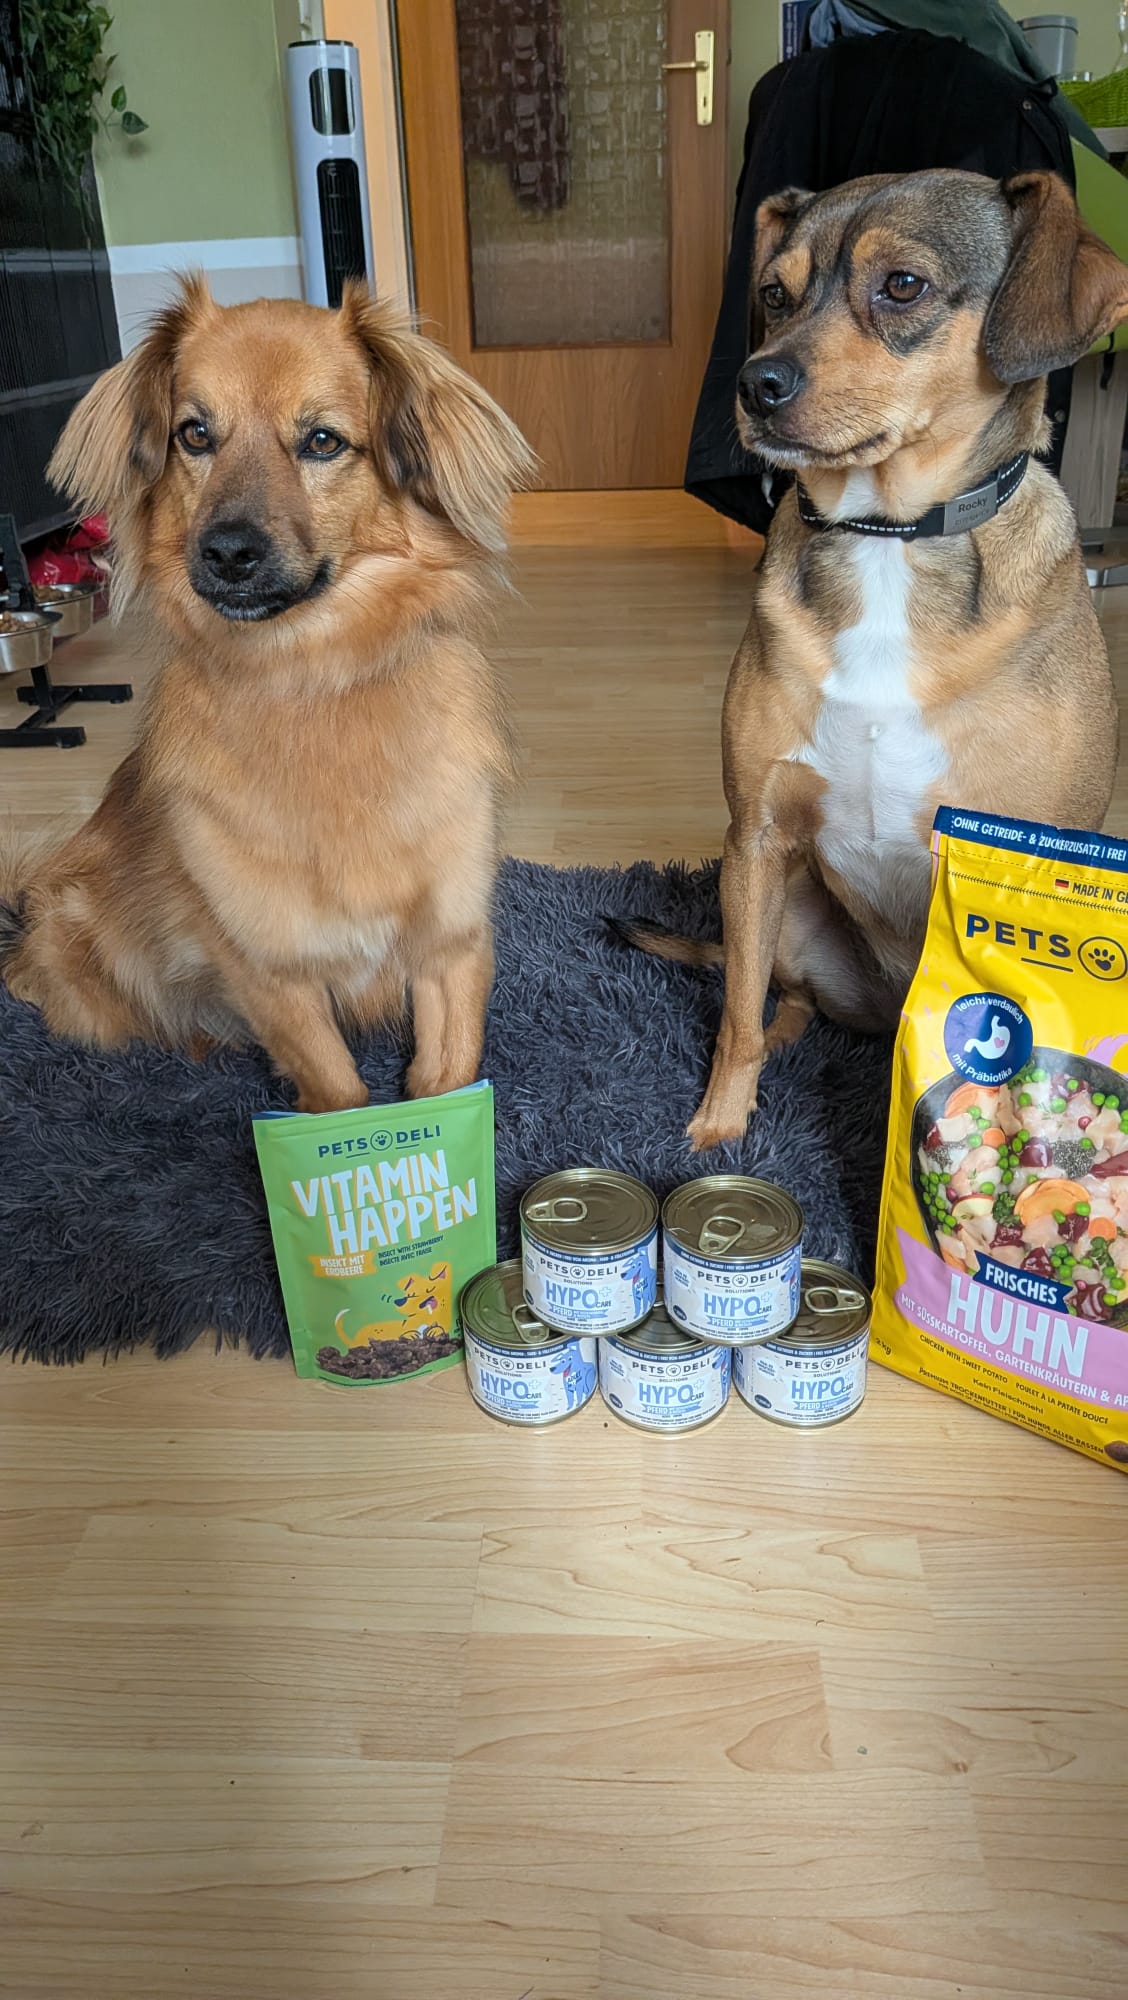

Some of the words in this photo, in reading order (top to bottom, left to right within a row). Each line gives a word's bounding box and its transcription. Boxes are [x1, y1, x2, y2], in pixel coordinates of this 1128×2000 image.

[958, 496, 988, 513] Rocky
[953, 816, 980, 832] OHNE
[981, 823, 1027, 842] GETREIDE-
[1028, 833, 1037, 845] &
[1038, 835, 1100, 857] ZUCKERZUSATZ
[1107, 847, 1127, 861] FREI
[1072, 882, 1100, 898] MADE
[1102, 887, 1113, 901] IN
[966, 913, 1072, 959] PETS
[955, 996, 986, 1012] leicht
[987, 998, 1024, 1025] verdaulich
[952, 1053, 967, 1070] mit
[965, 1066, 1013, 1083] Präbiotika
[317, 1136, 368, 1158] PETS
[396, 1124, 441, 1143] DELI
[291, 1149, 449, 1217] VITAMIN
[327, 1177, 478, 1256] HAPPEN
[350, 1254, 364, 1265] MIT
[397, 1244, 411, 1254] WITH
[540, 1257, 569, 1274] PETS
[588, 1266, 617, 1277] DELI
[697, 1270, 730, 1285] PETS
[751, 1270, 779, 1284] DELI
[546, 1279, 599, 1309] HYPO
[985, 1263, 1058, 1305] FRISCHES
[704, 1293, 761, 1317] HYPO
[712, 1317, 734, 1327] PFERD
[946, 1273, 1089, 1378] HUHN
[474, 1346, 499, 1366] PETS
[517, 1361, 546, 1370] DELI
[785, 1360, 818, 1370] PETS
[837, 1348, 860, 1366] DELI
[901, 1292, 916, 1312] MIT
[995, 1349, 1097, 1399] GARTENKRÄUTERN
[1100, 1390, 1110, 1403] &
[920, 1334, 945, 1353] CHICKEN
[946, 1349, 961, 1362] WITH
[962, 1358, 981, 1372] SWEET
[982, 1367, 1008, 1383] POTATO
[632, 1361, 664, 1374] PETS
[684, 1358, 710, 1373] DELI
[480, 1369, 529, 1399] HYPO
[639, 1382, 693, 1405] HYPO
[791, 1377, 845, 1400] HYPO
[973, 1378, 992, 1391] Kein
[992, 1386, 1044, 1415] Fleischmehl
[951, 1381, 1007, 1411] TROCKENFUTTER
[1012, 1408, 1026, 1419] FÜR
[1028, 1417, 1051, 1431] HUNDE
[1053, 1428, 1074, 1441] ALLER
[1076, 1438, 1104, 1454] RASSEN
[1015, 1382, 1039, 1398] POULET
[1047, 1396, 1056, 1405] LA
[1057, 1401, 1081, 1416] PATATE
[1082, 1411, 1109, 1425] DOUCE
